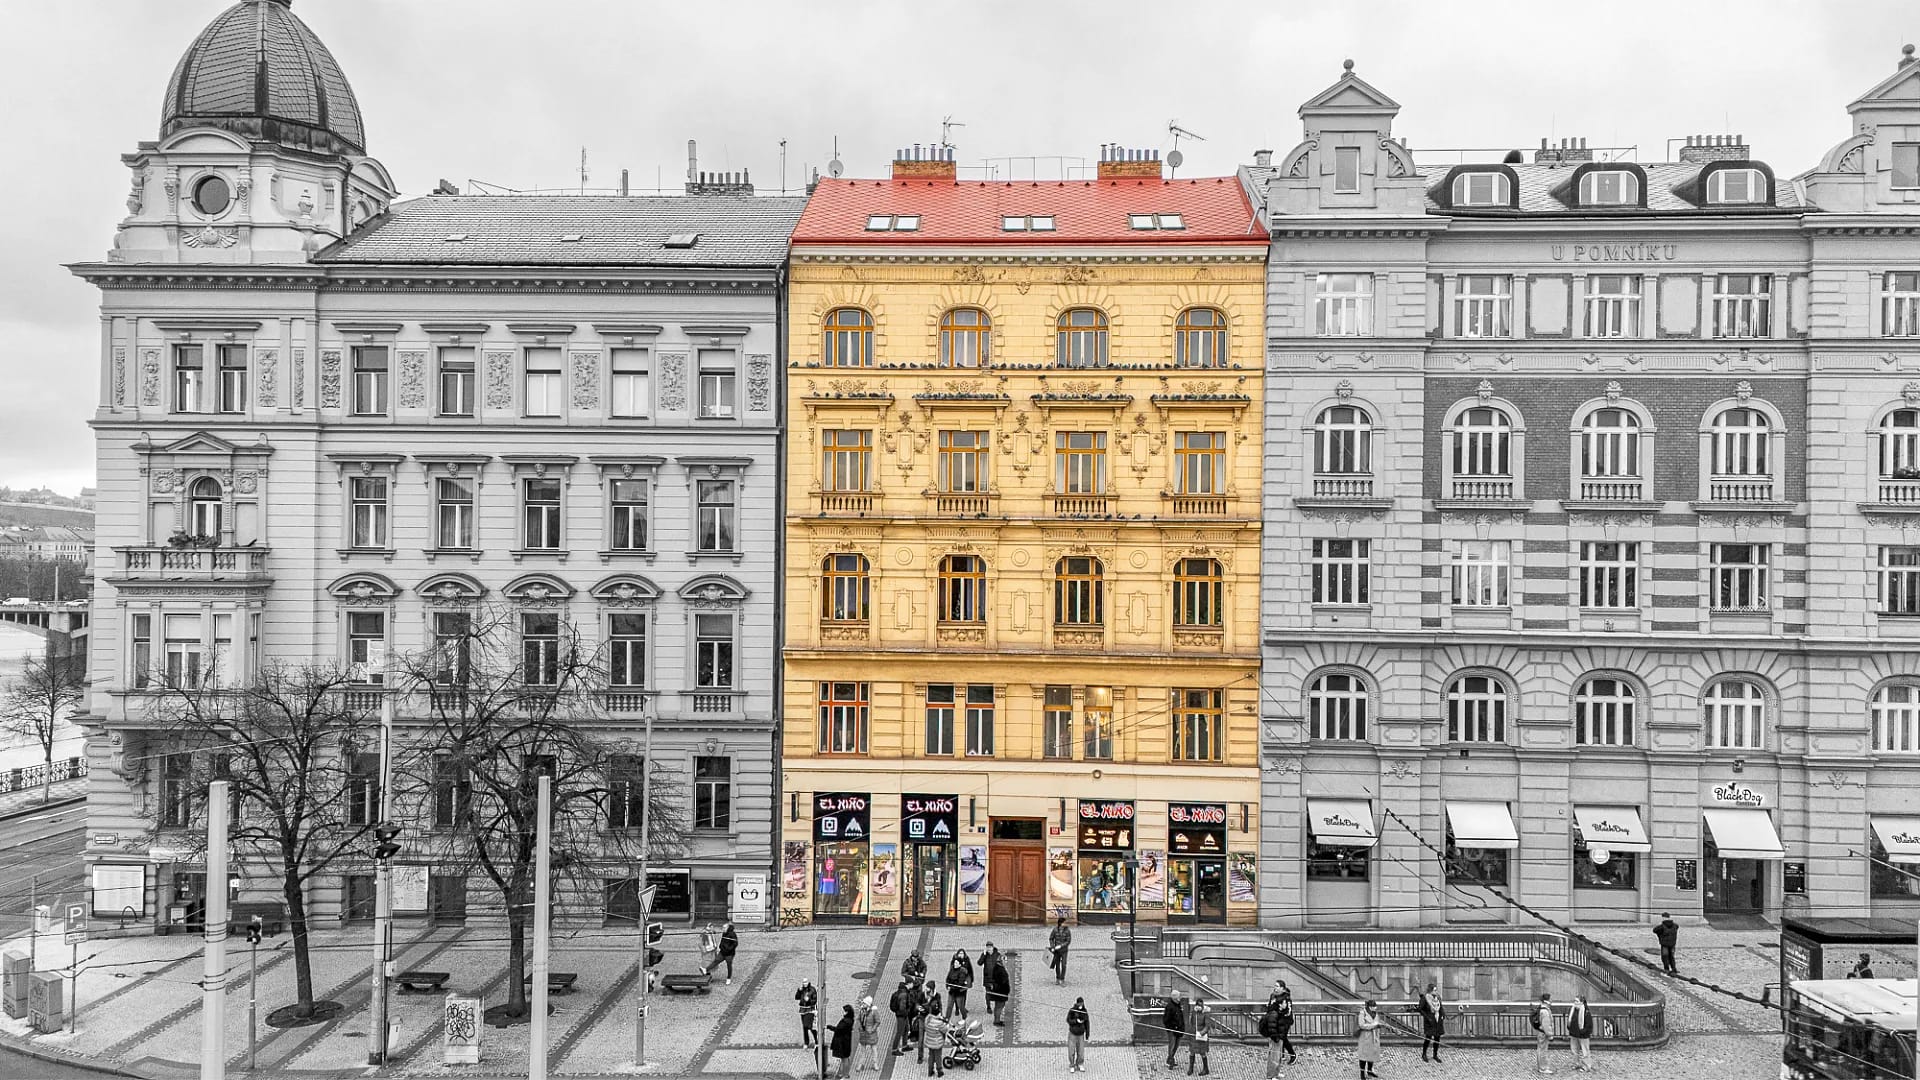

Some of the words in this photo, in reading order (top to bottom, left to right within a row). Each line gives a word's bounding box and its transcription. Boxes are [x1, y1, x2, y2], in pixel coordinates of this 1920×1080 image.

[1551, 245, 1566, 261] U
[1574, 243, 1677, 261] POMNÍKU
[820, 799, 836, 810] EL
[837, 797, 866, 811] NIÑO
[906, 800, 923, 811] EL
[924, 799, 954, 813] NIÑO
[1080, 803, 1100, 819] EL
[1170, 806, 1190, 822] EL
[69, 906, 83, 924] P
